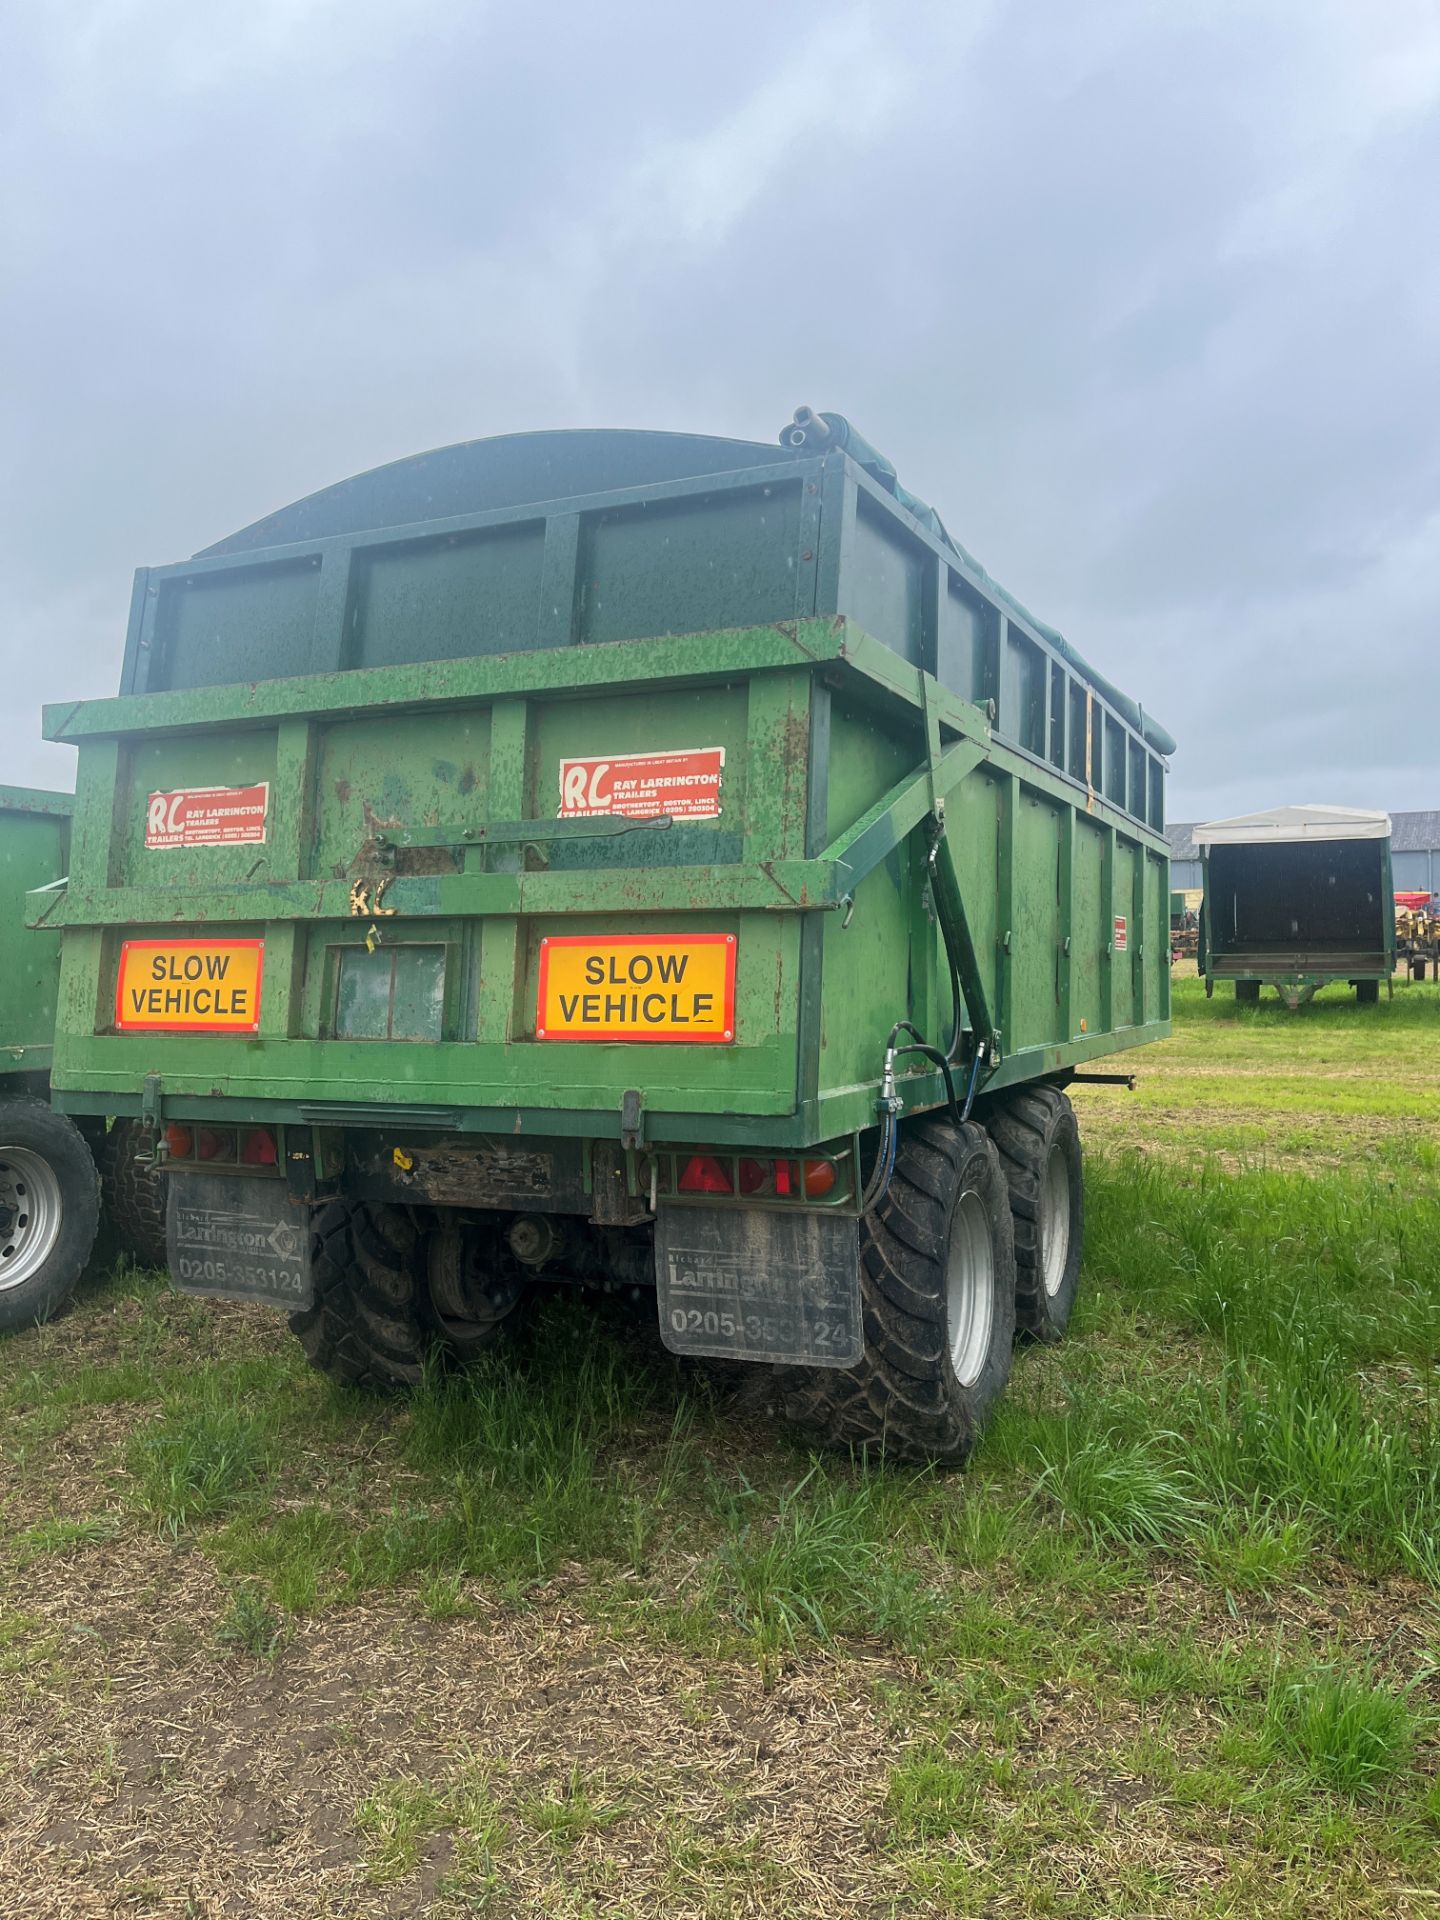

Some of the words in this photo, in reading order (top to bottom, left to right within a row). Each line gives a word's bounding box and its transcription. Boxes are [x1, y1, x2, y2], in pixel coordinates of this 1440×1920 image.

[613, 779, 638, 791] RAY
[640, 774, 718, 789] LARRINGTON
[613, 789, 657, 799] TRAILERS
[185, 818, 219, 826] TRAILERS
[186, 809, 205, 819] RAY
[206, 805, 264, 817] LARRINGTON
[147, 834, 184, 844] TRAILERS
[151, 955, 230, 981] SLOW
[585, 954, 689, 985] SLOW
[131, 988, 247, 1014] VEHICLE
[559, 993, 714, 1023] VEHICLE
[179, 1257, 303, 1293] 0205-353124
